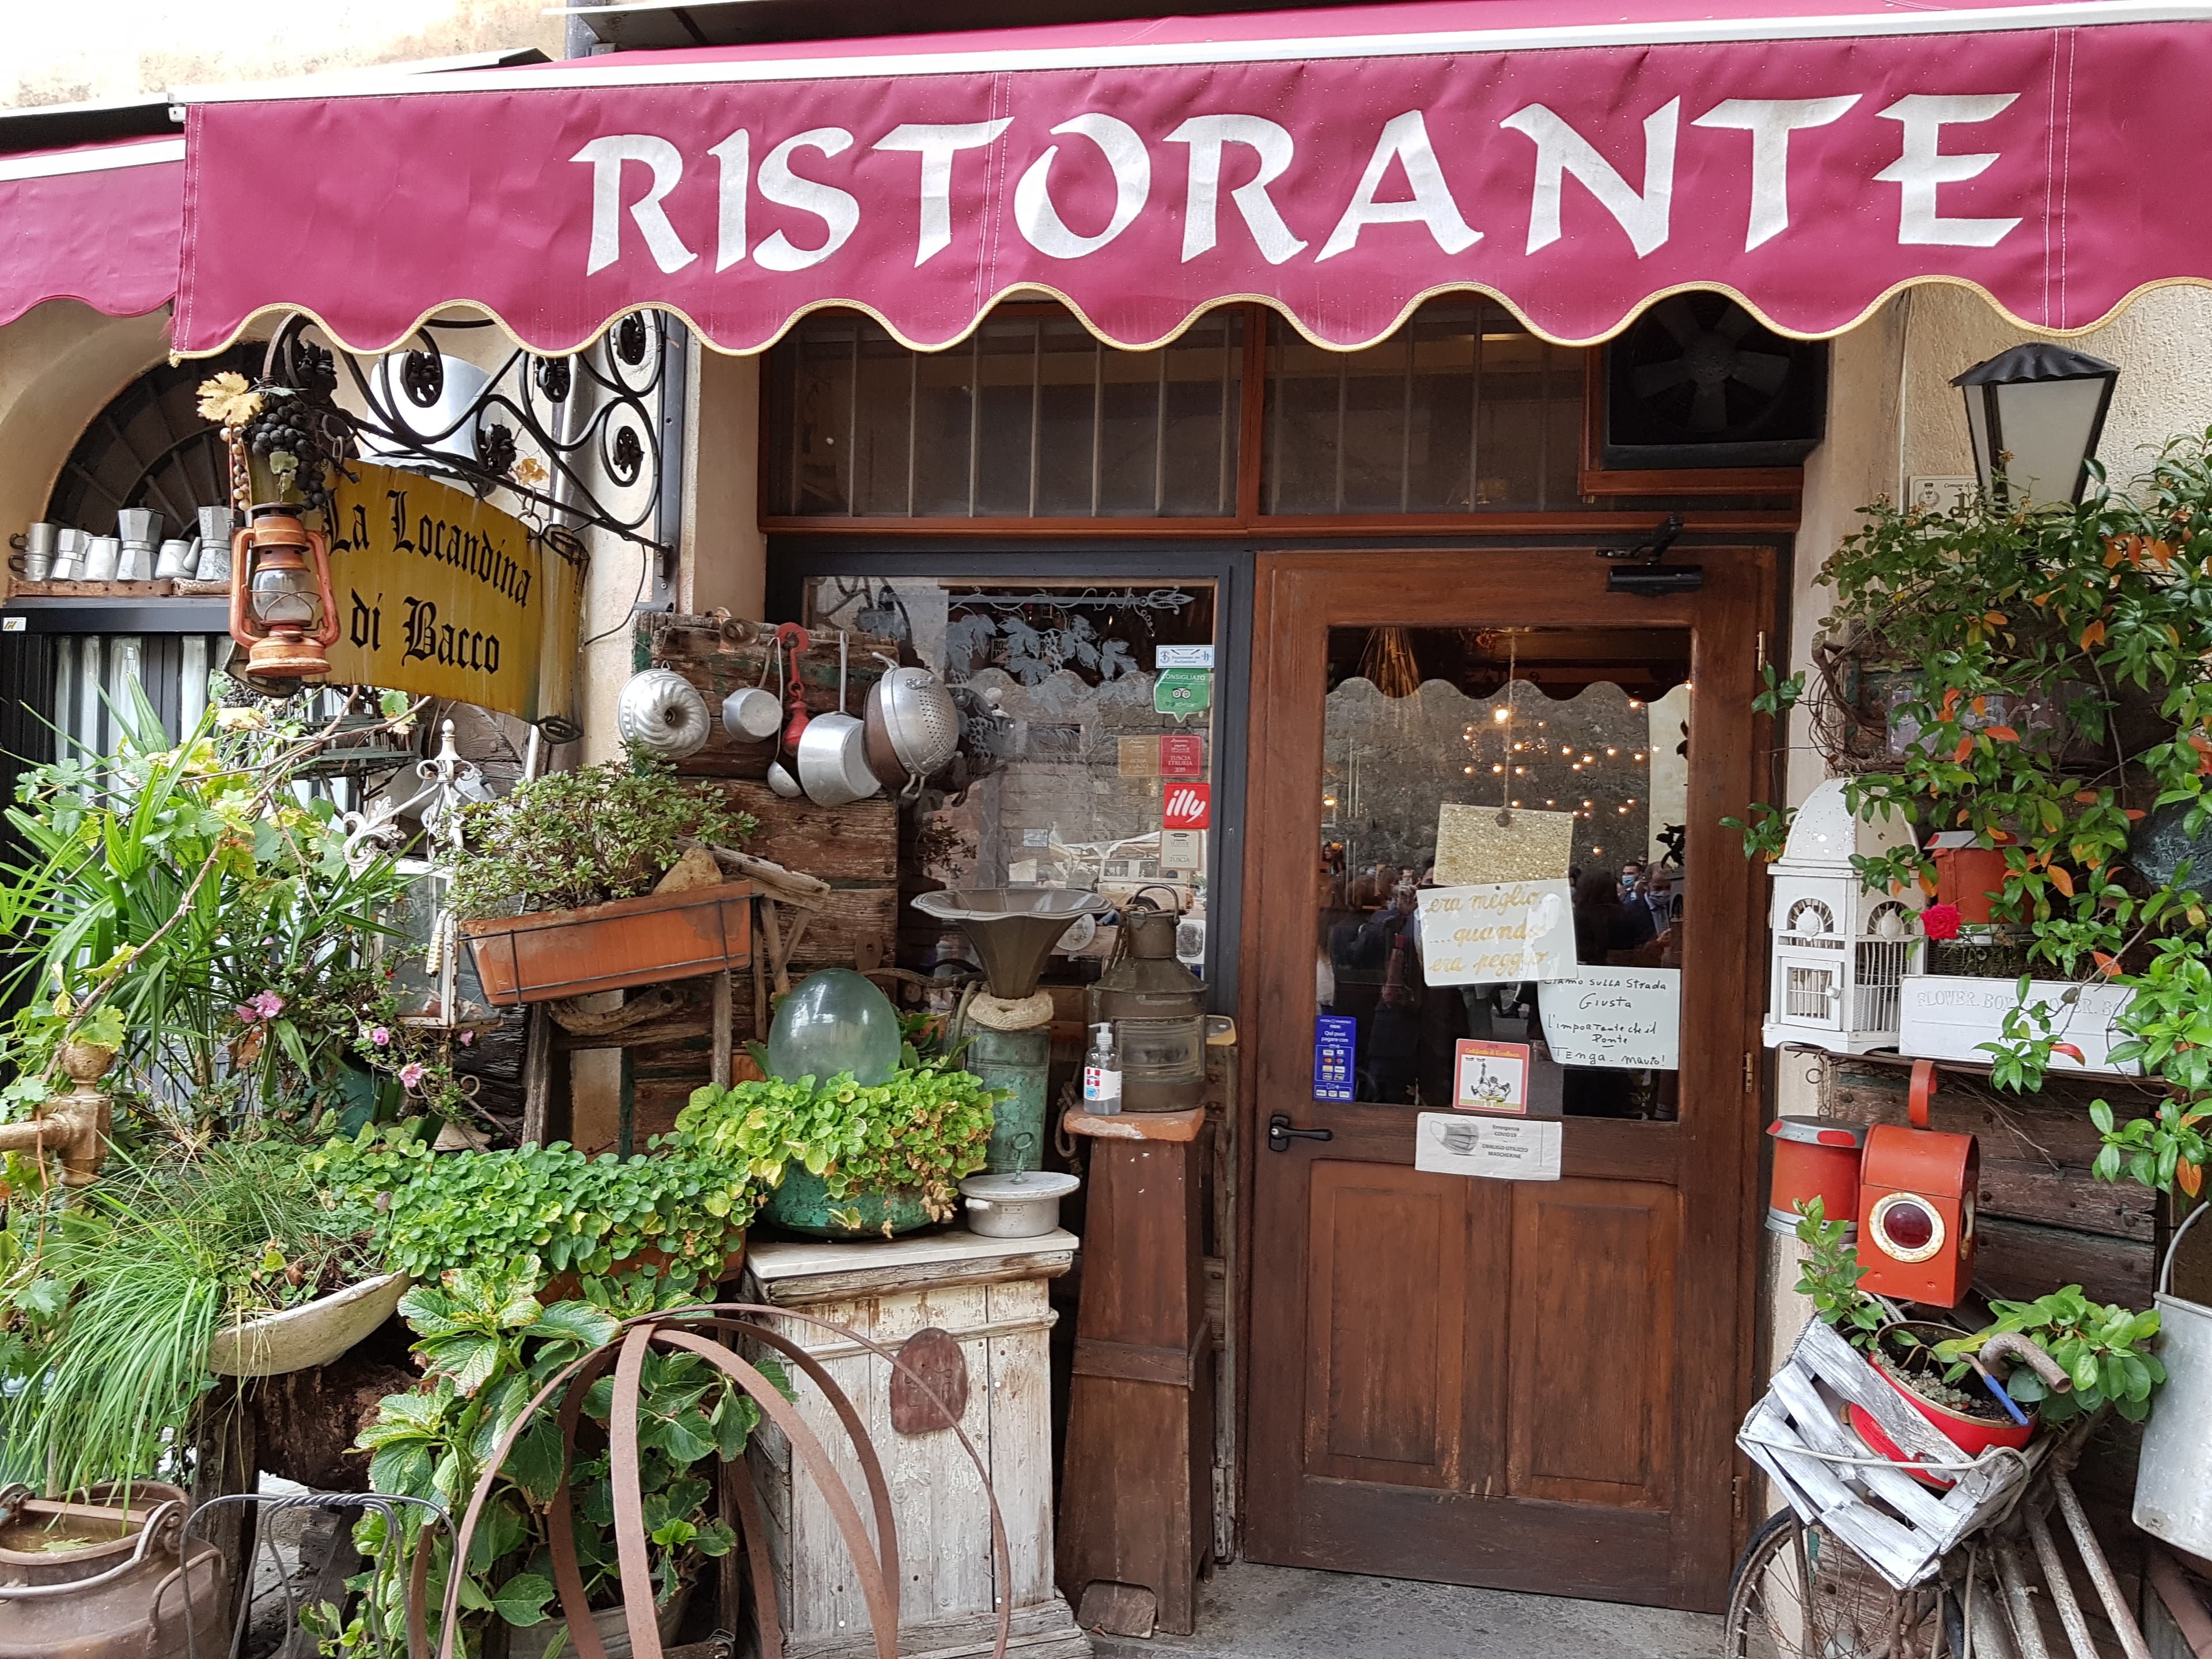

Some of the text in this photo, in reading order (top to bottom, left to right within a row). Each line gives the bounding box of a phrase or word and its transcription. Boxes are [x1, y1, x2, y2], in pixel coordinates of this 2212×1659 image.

[568, 93, 2023, 276] RISTORANTE
[323, 487, 532, 608] La Locandina
[350, 588, 499, 675] di Bacco
[1166, 789, 1206, 823] illy
[1425, 897, 1463, 914] era
[1428, 951, 1549, 977] era peggo
[1488, 1151, 1521, 1159] MASCHERINE
